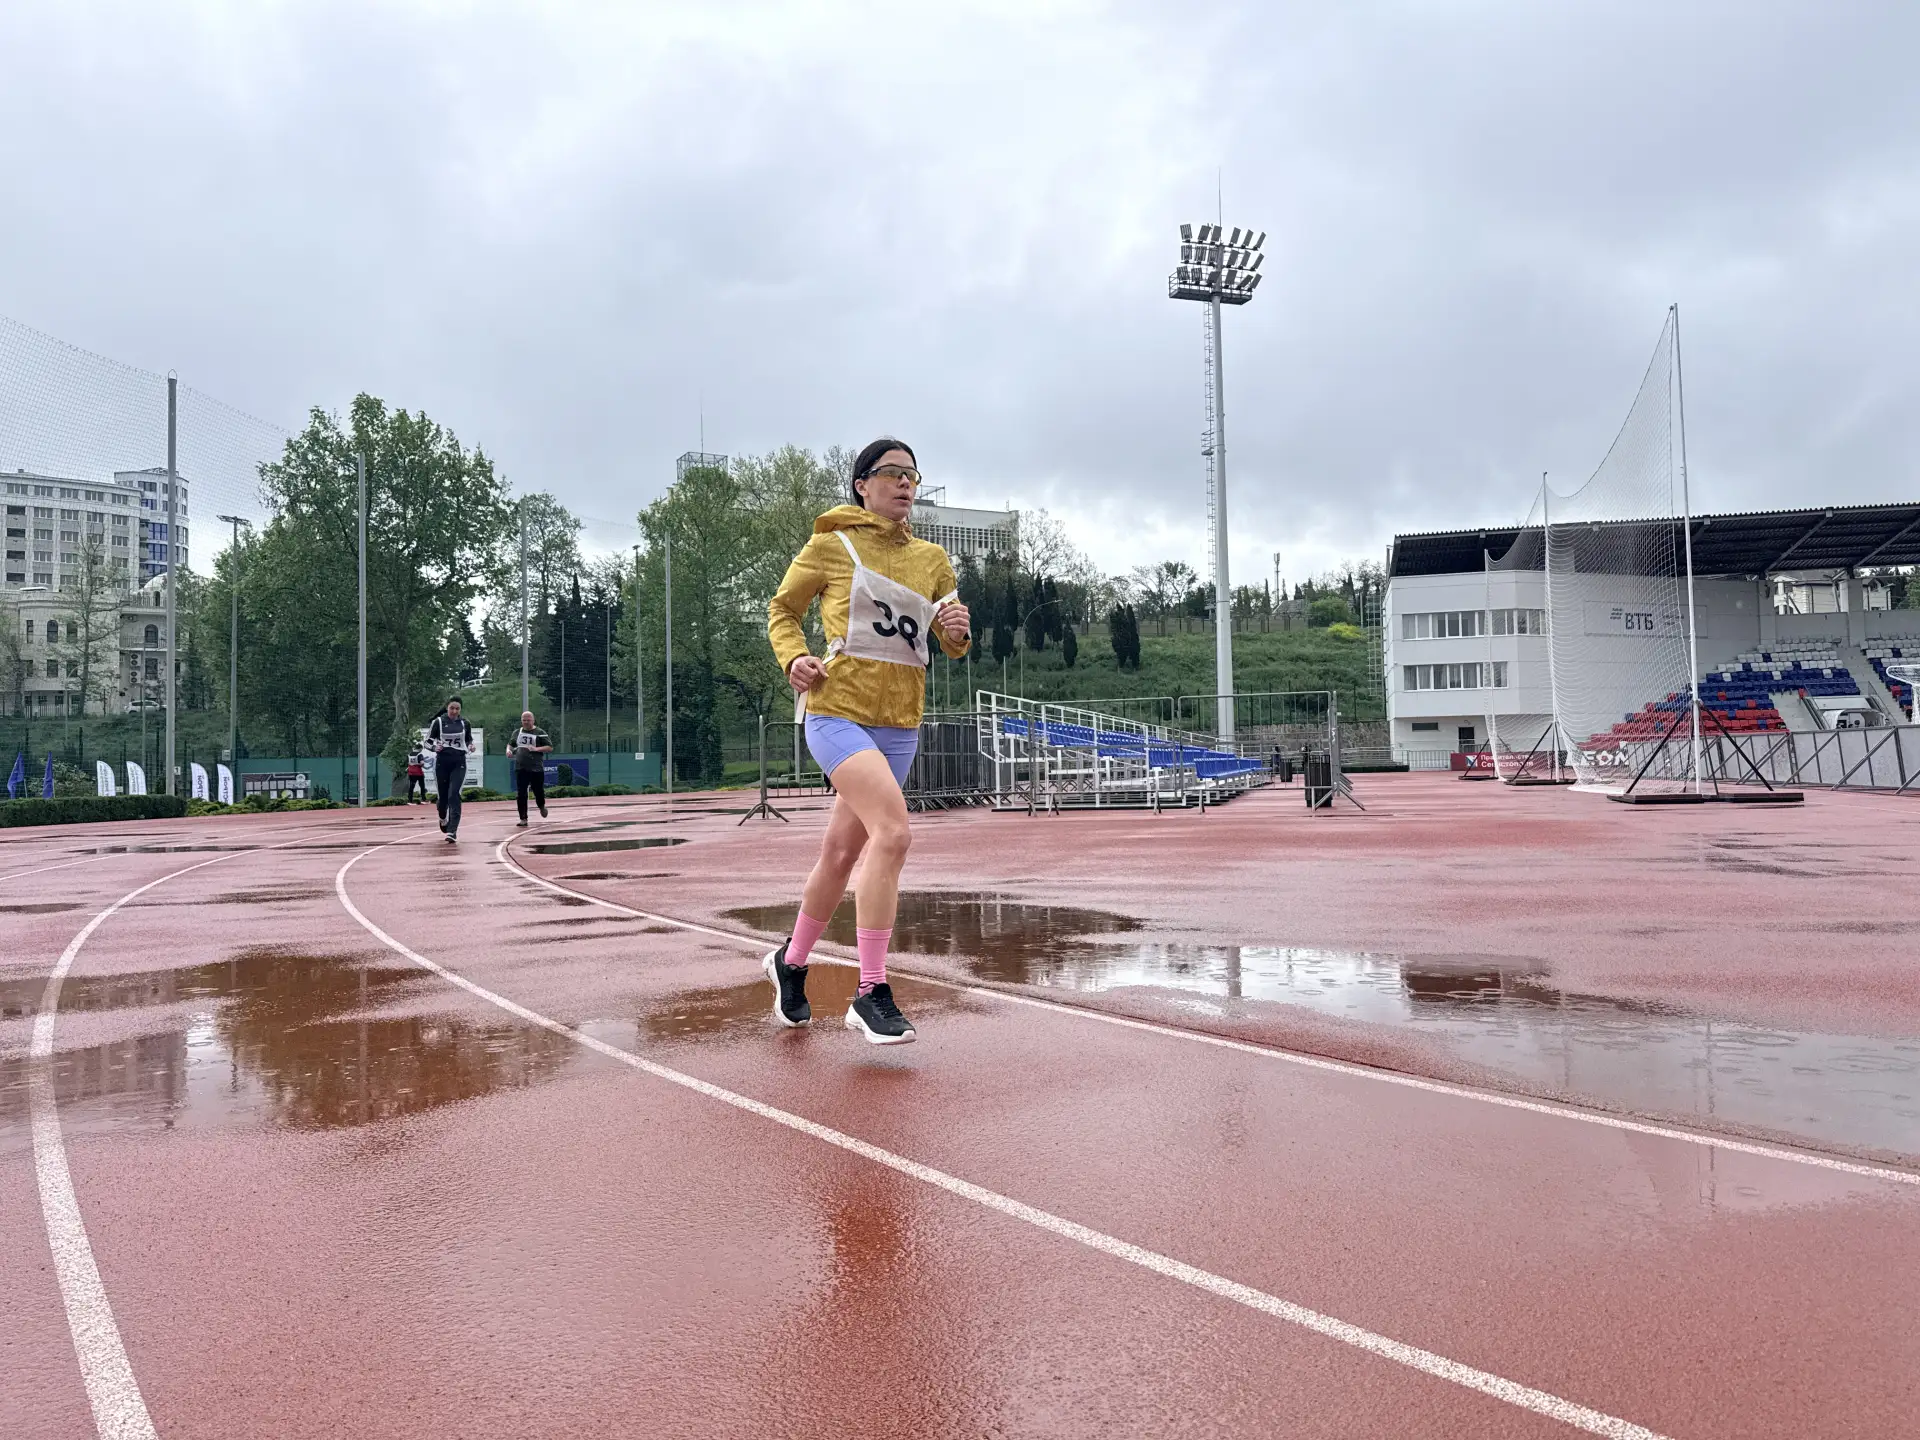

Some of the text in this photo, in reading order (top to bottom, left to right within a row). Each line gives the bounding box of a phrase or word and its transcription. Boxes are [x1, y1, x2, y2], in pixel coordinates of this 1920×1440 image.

[1625, 612, 1653, 631] ВТБ
[445, 738, 461, 748] 75
[521, 736, 533, 745] 31
